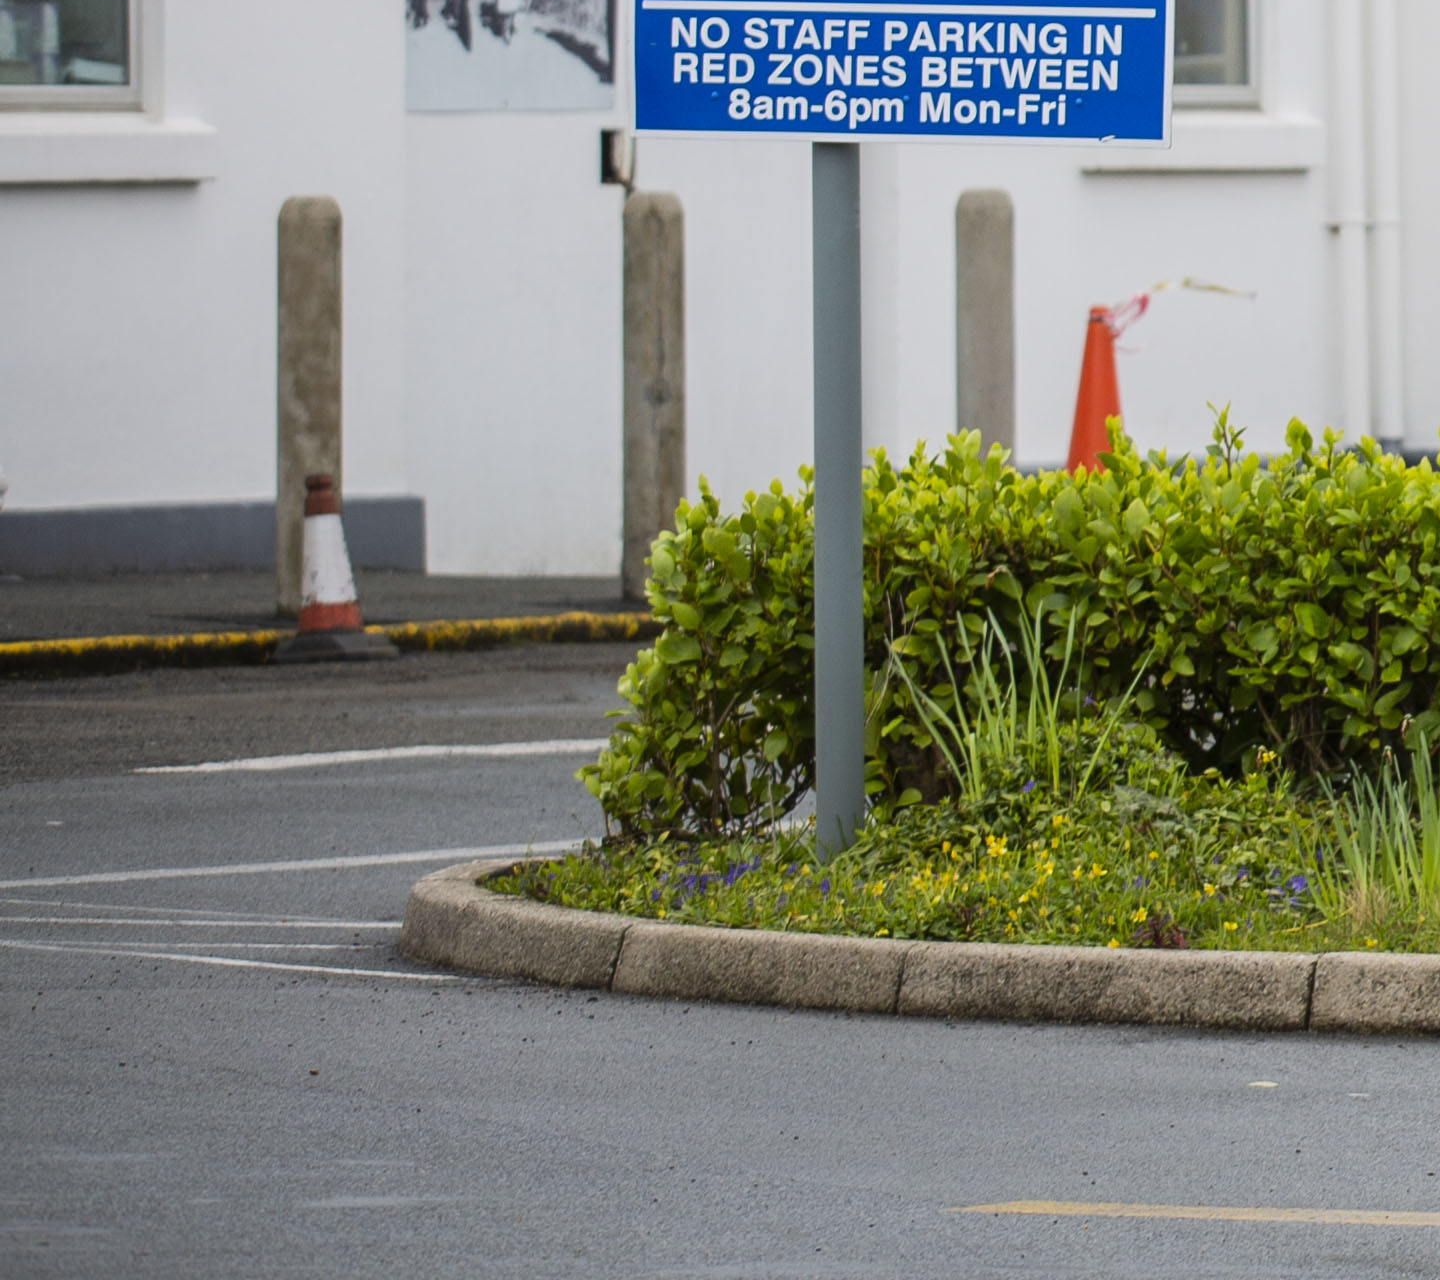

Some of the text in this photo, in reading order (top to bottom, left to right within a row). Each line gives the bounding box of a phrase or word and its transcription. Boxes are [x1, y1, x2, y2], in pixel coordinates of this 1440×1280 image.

[671, 17, 1123, 56] NO STAFF PARKING IN
[673, 52, 1118, 91] RED ZONES BETWEEN
[728, 88, 1066, 130] 8am-6pm Mon-Fri
